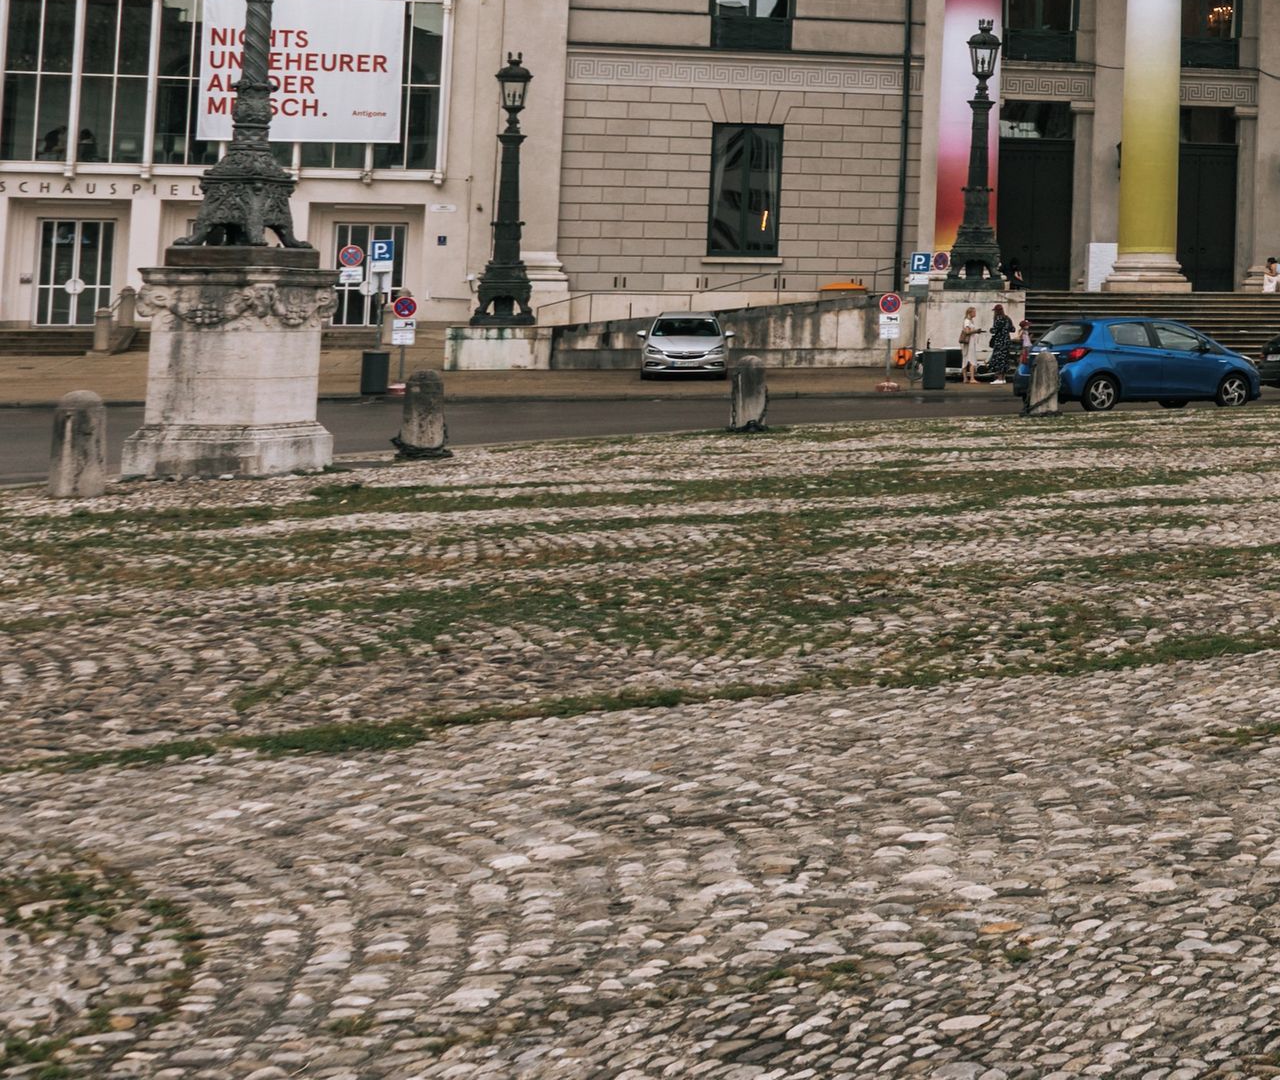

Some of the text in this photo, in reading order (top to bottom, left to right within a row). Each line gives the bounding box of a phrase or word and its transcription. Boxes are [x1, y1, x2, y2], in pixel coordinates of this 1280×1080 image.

[208, 50, 388, 73] UNEHEURER
[206, 73, 238, 92] AL
[352, 110, 387, 118] Antigone
[374, 242, 388, 260] P
[913, 254, 925, 270] P
